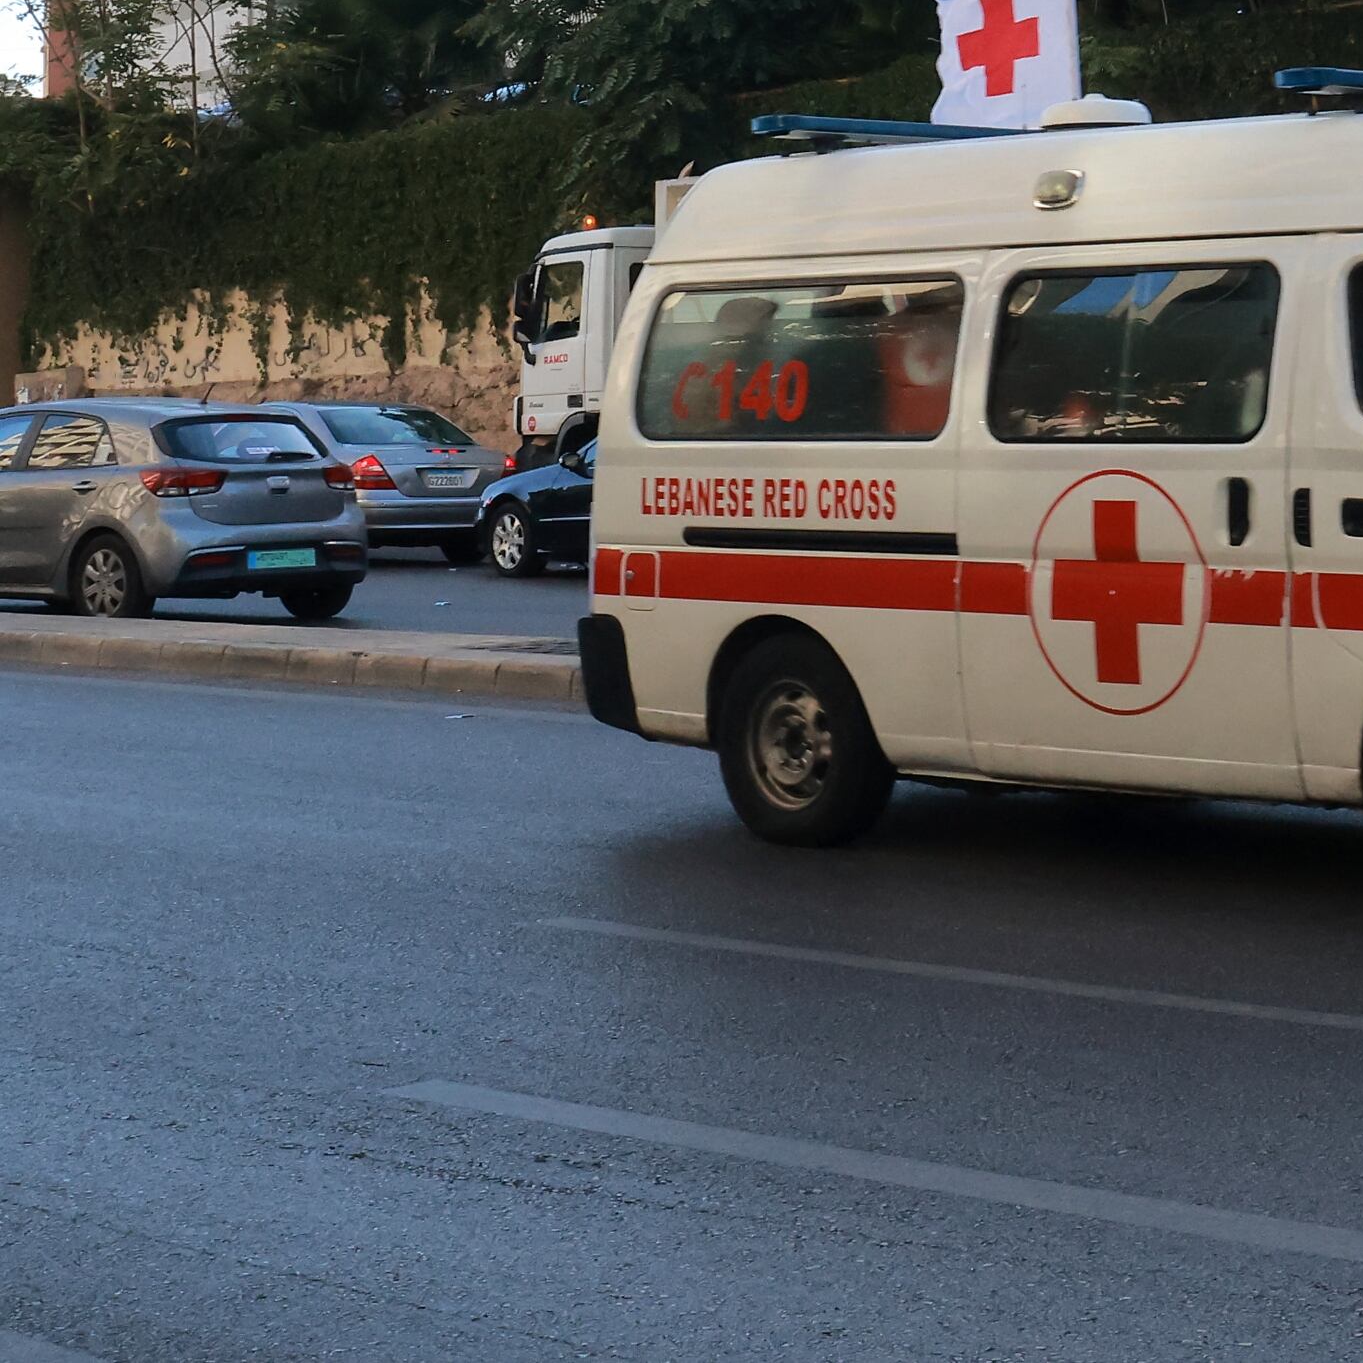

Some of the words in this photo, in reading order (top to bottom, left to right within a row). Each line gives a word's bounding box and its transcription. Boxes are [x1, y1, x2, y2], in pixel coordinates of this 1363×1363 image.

[544, 354, 568, 364] RAMCO
[711, 359, 808, 422] 140
[641, 478, 754, 517] LEBANESE
[763, 478, 807, 518] RED
[818, 479, 896, 520] CROSS
